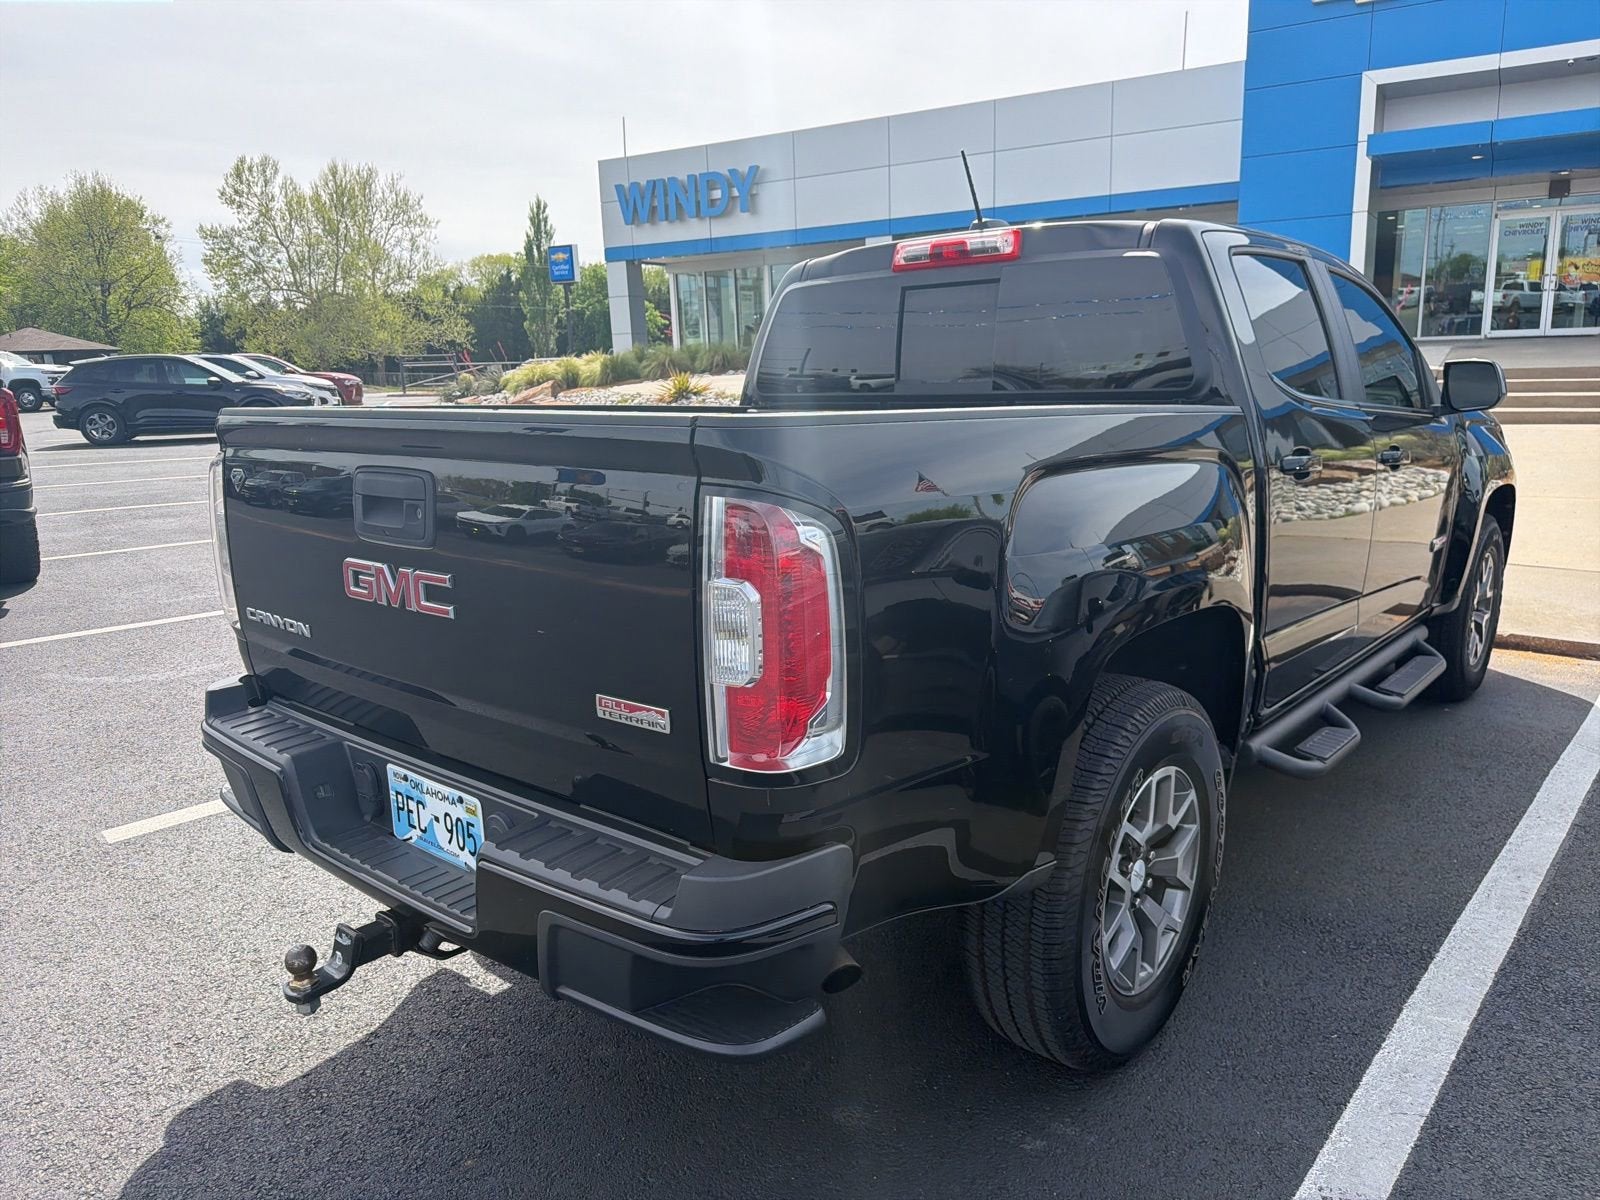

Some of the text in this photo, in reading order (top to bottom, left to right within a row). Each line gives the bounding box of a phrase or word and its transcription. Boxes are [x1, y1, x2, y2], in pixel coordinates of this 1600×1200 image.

[614, 164, 760, 226] WINDY
[1504, 228, 1545, 237] CHEVROLET
[1519, 221, 1545, 229] WINDY
[342, 557, 455, 620] GMC
[246, 606, 312, 639] CANYON
[600, 709, 667, 731] TERRAIN
[601, 699, 630, 713] ALL
[409, 778, 458, 808] OKLAHOMA
[395, 790, 478, 857] PEC 905
